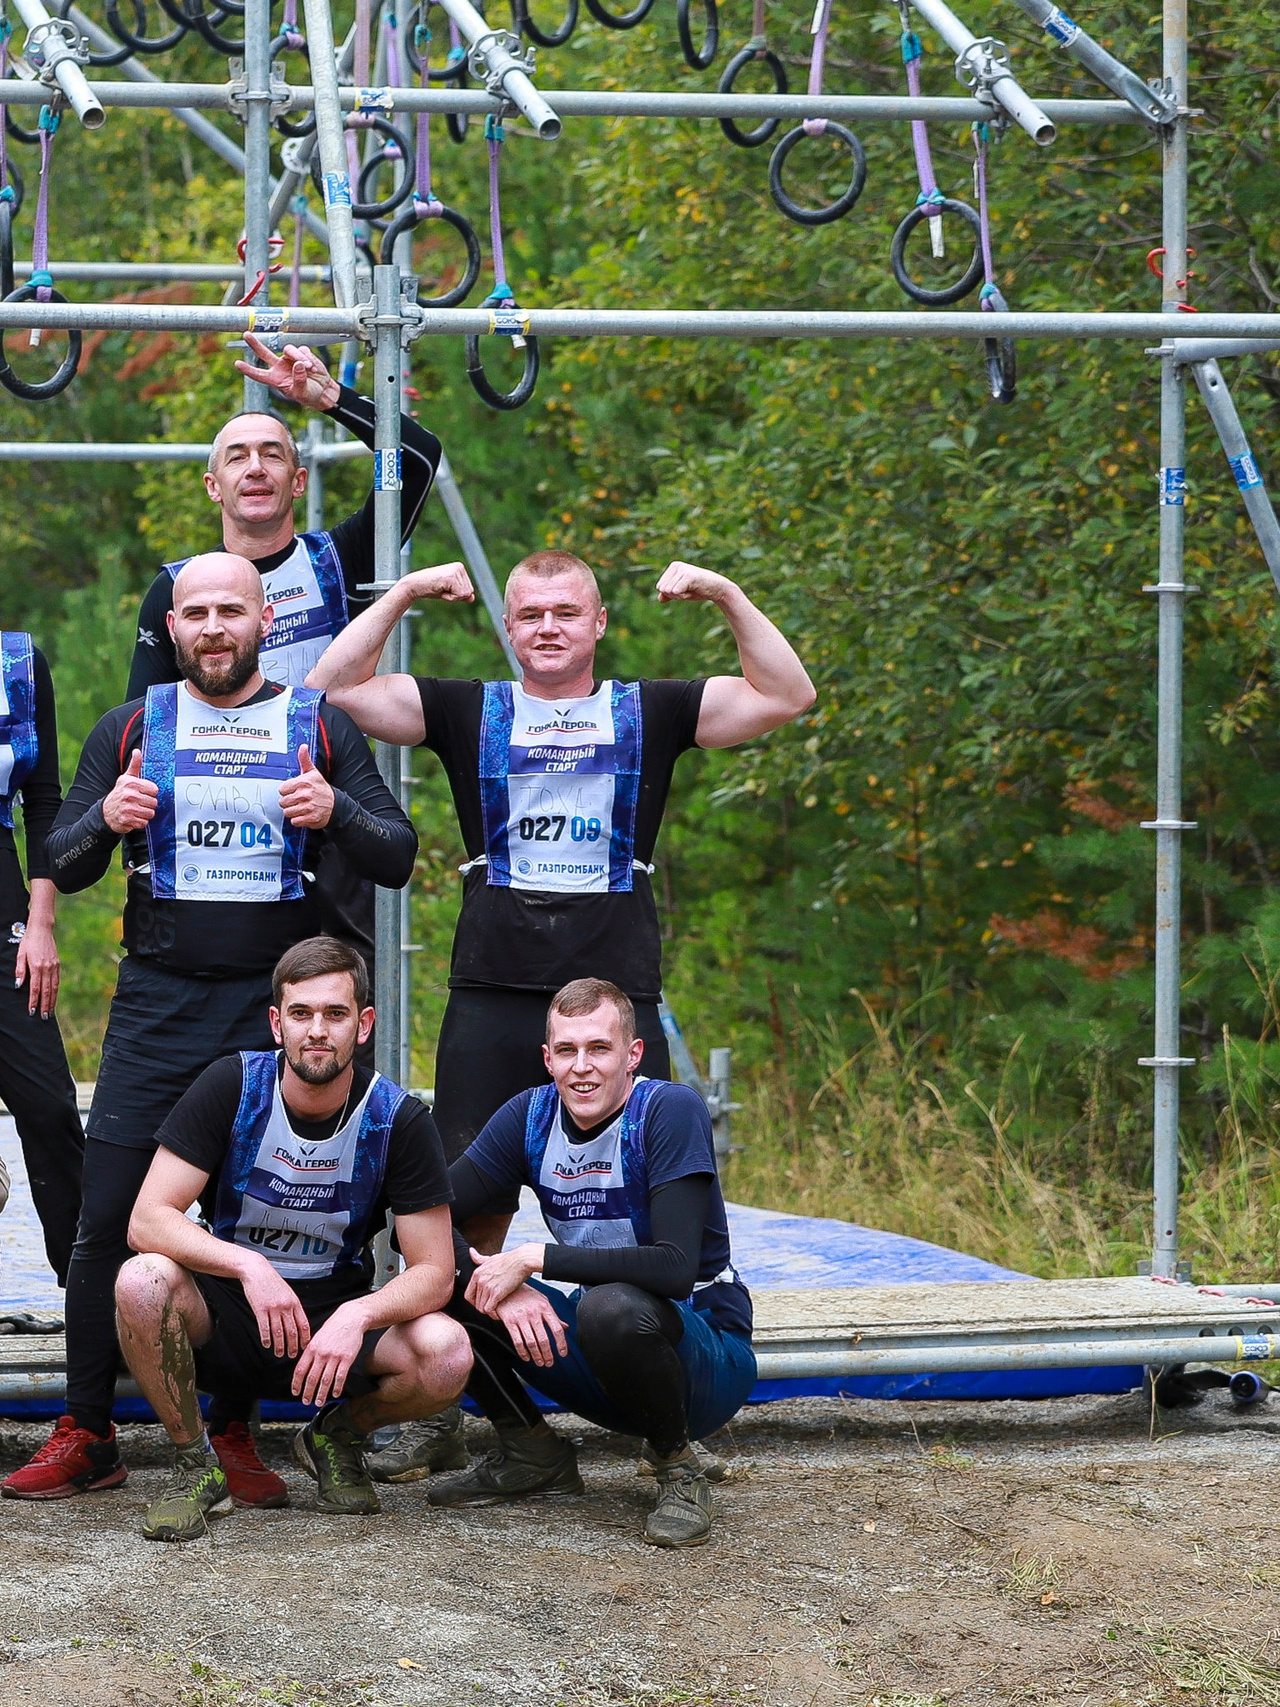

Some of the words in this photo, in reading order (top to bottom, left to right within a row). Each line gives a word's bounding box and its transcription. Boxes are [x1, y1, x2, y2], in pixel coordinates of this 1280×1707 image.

[266, 586, 304, 603] ГЕРОЕВ
[265, 630, 295, 648] СТАРТ
[192, 725, 228, 734] ГОНКА
[230, 726, 271, 737] ГЕРОЕВ
[528, 721, 559, 734] ГОНКА
[561, 720, 598, 730] ГЕРОЕВ
[194, 751, 267, 764] КОМАНДНЫЙ
[527, 745, 596, 762] КОМАНДНЫЙ
[214, 764, 248, 776] СТАРТ
[545, 762, 578, 772] СТАРТ
[185, 783, 266, 817] СЛАВА
[537, 862, 605, 875] ГАЗПРОМБАНК
[206, 869, 277, 882] ГАЗПРОМБАНК
[576, 1161, 613, 1174] ГЕРОЕВ
[268, 1178, 336, 1199] КОМАНДНЫЙ
[280, 1197, 315, 1209] СТАРТ
[552, 1190, 606, 1206] КОМАНДНЫЙ
[568, 1205, 596, 1218] СТАРТ
